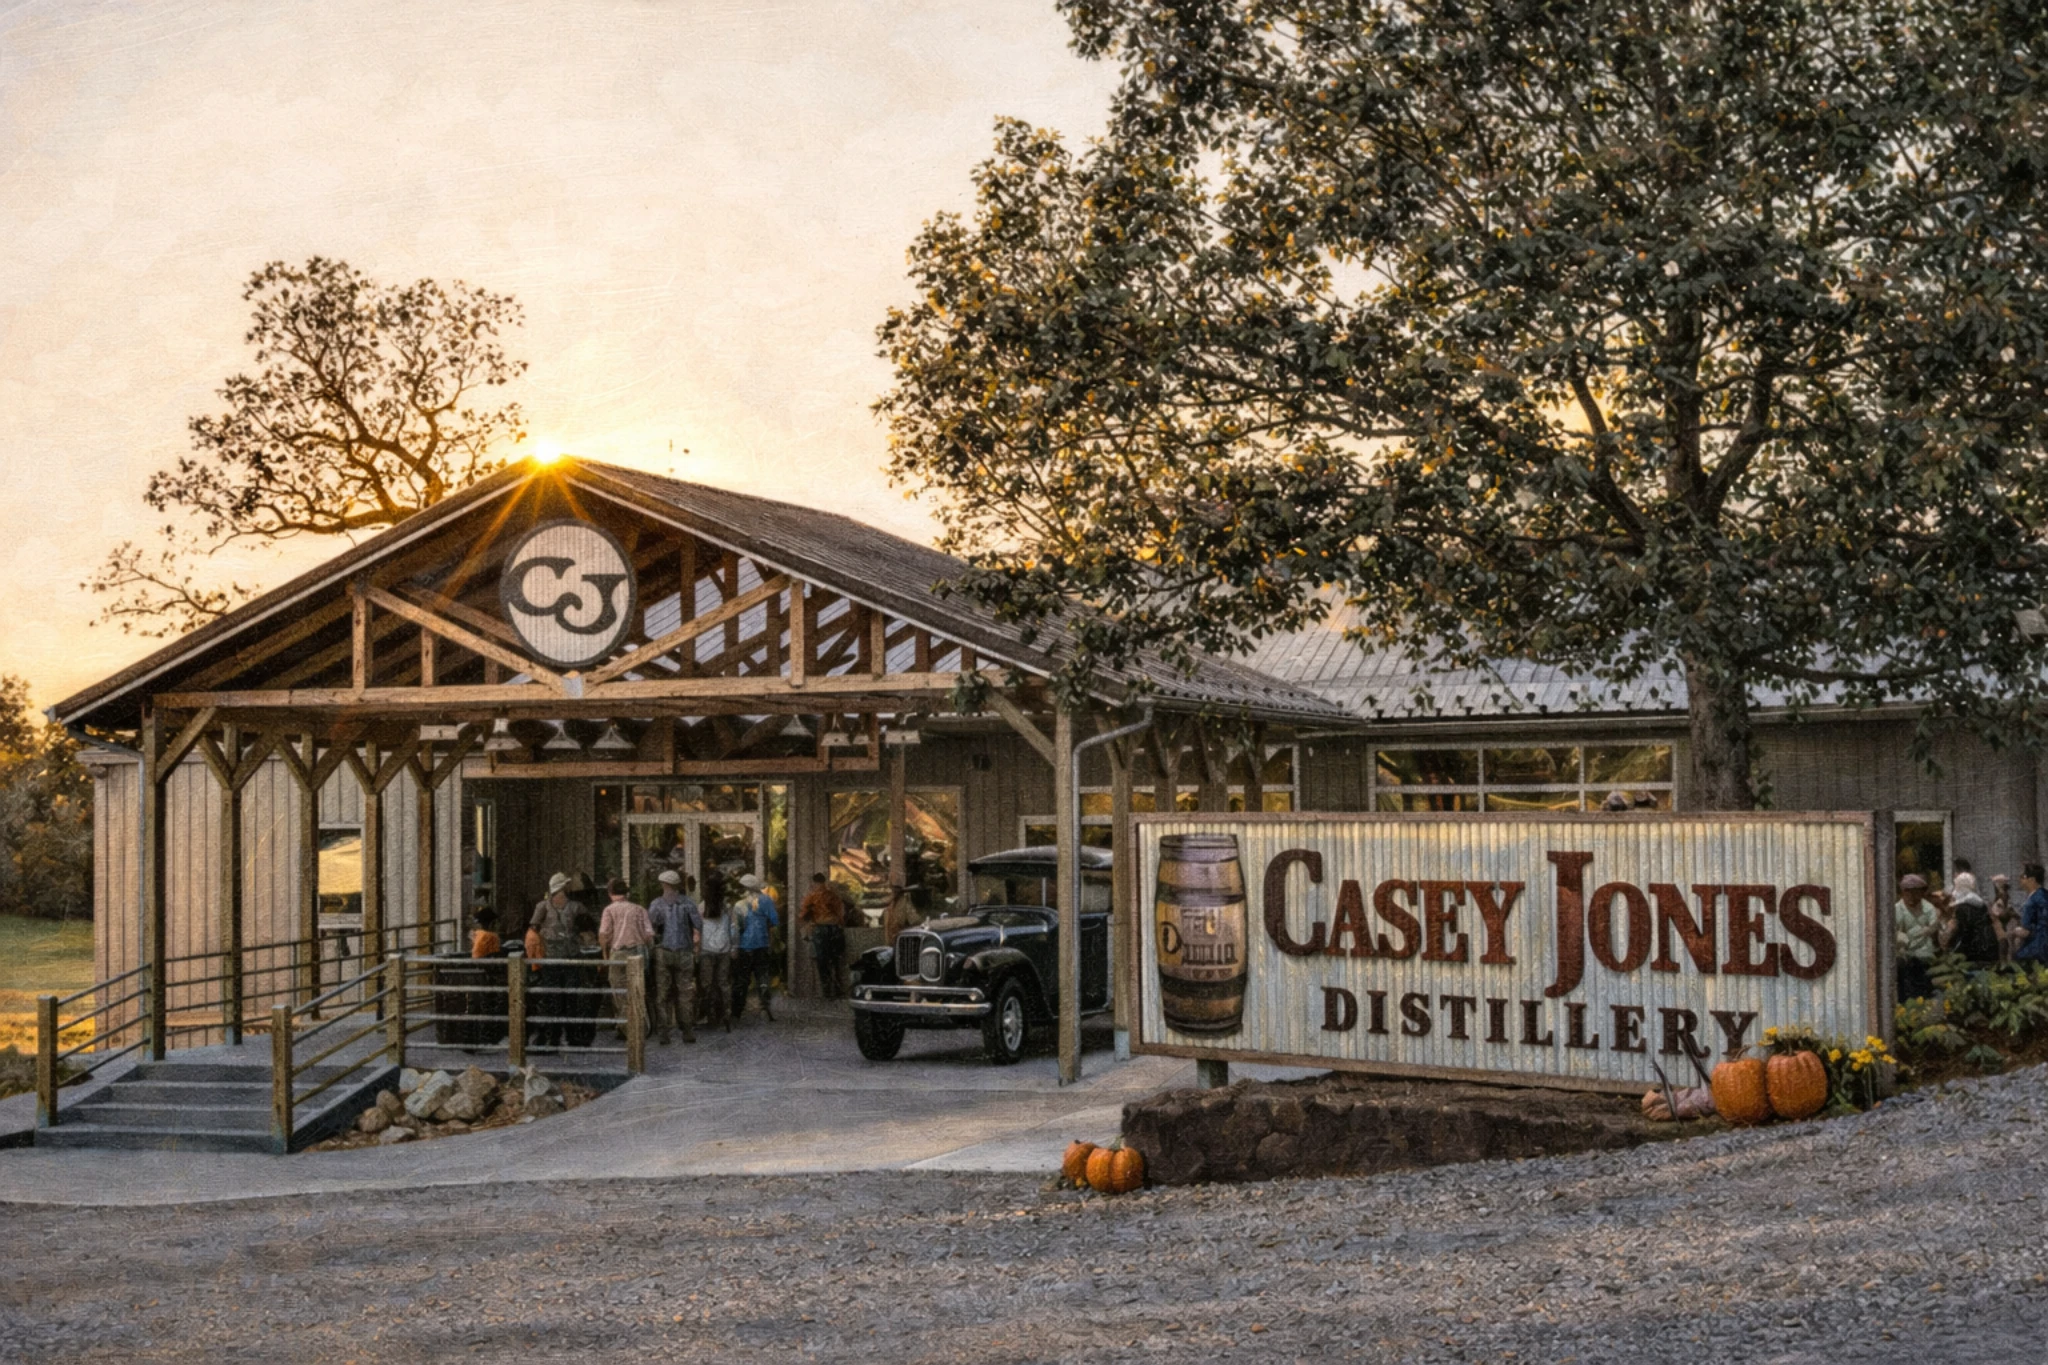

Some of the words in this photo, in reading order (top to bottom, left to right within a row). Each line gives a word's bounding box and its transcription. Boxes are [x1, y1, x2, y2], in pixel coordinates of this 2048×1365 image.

[1264, 848, 1526, 965] CASEY
[1545, 851, 1837, 998] JONES
[1321, 986, 1758, 1058] DISTILLERY
